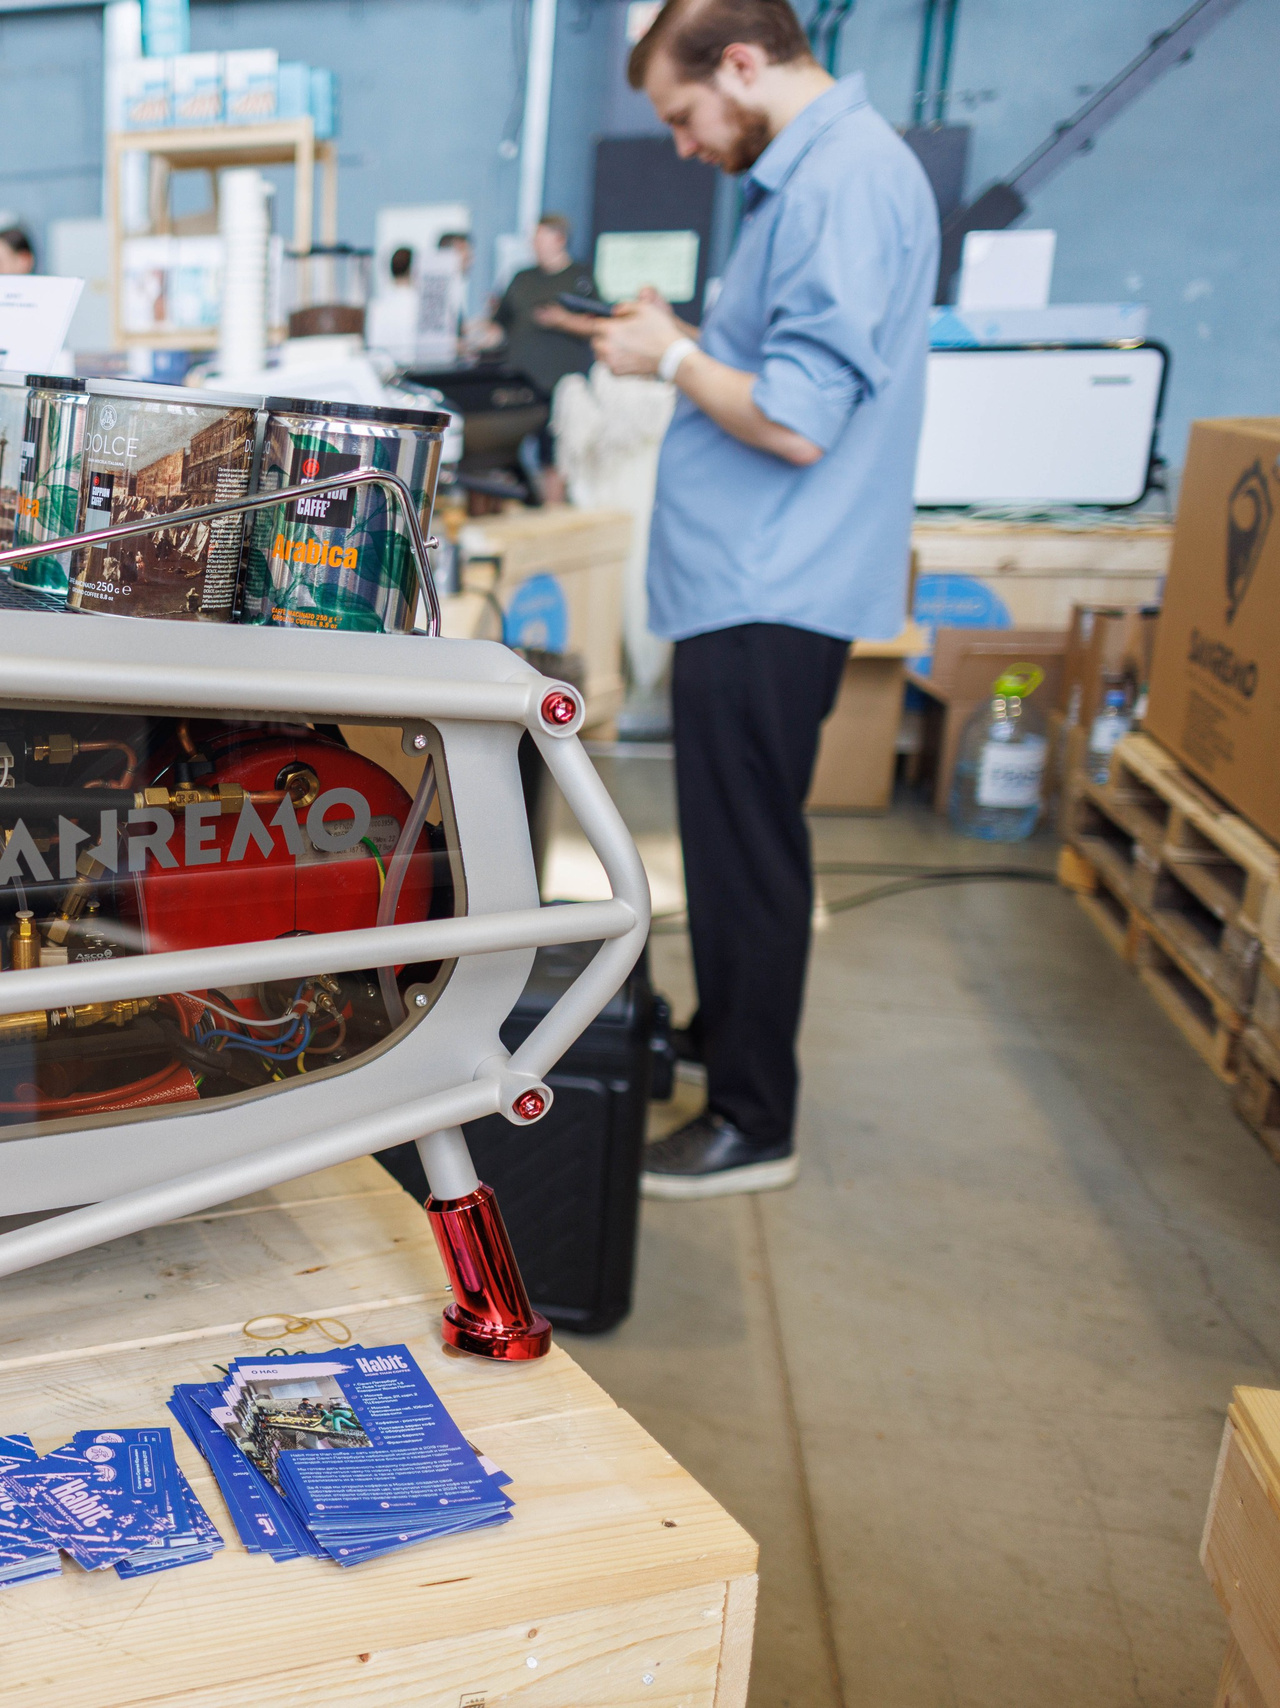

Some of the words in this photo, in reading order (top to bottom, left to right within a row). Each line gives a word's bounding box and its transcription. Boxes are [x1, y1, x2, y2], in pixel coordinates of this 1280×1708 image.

[85, 432, 139, 458] DOLCE
[272, 534, 358, 569] Arabica
[96, 581, 114, 592] 250
[288, 610, 315, 619] MACINATO
[296, 618, 317, 626] COFFEE
[356, 1354, 408, 1374] Habit
[42, 1493, 56, 1506] MORE
[54, 1504, 68, 1518] THAN
[65, 1514, 84, 1532] COFFEE
[50, 1478, 114, 1527] Habit
